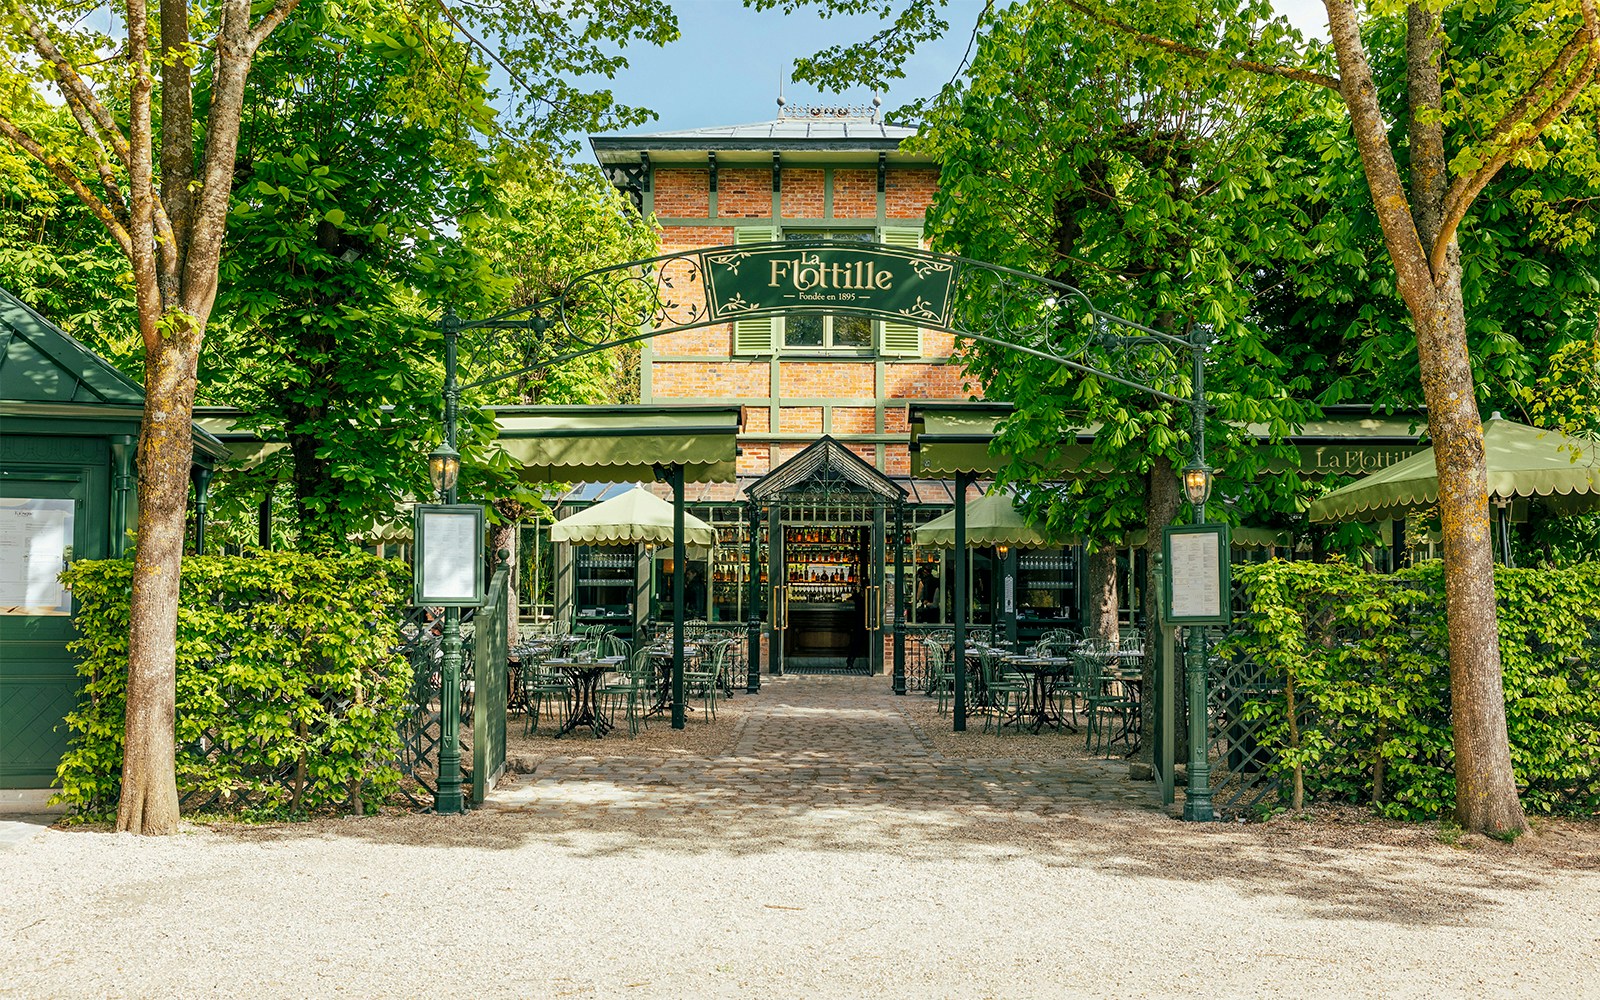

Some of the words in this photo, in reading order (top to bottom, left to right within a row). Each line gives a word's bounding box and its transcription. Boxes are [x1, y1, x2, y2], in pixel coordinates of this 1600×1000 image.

[800, 252, 820, 265] La
[768, 259, 893, 291] Flottille
[799, 292, 825, 301] Fondée
[838, 292, 856, 301] 1895
[1316, 450, 1340, 468] La
